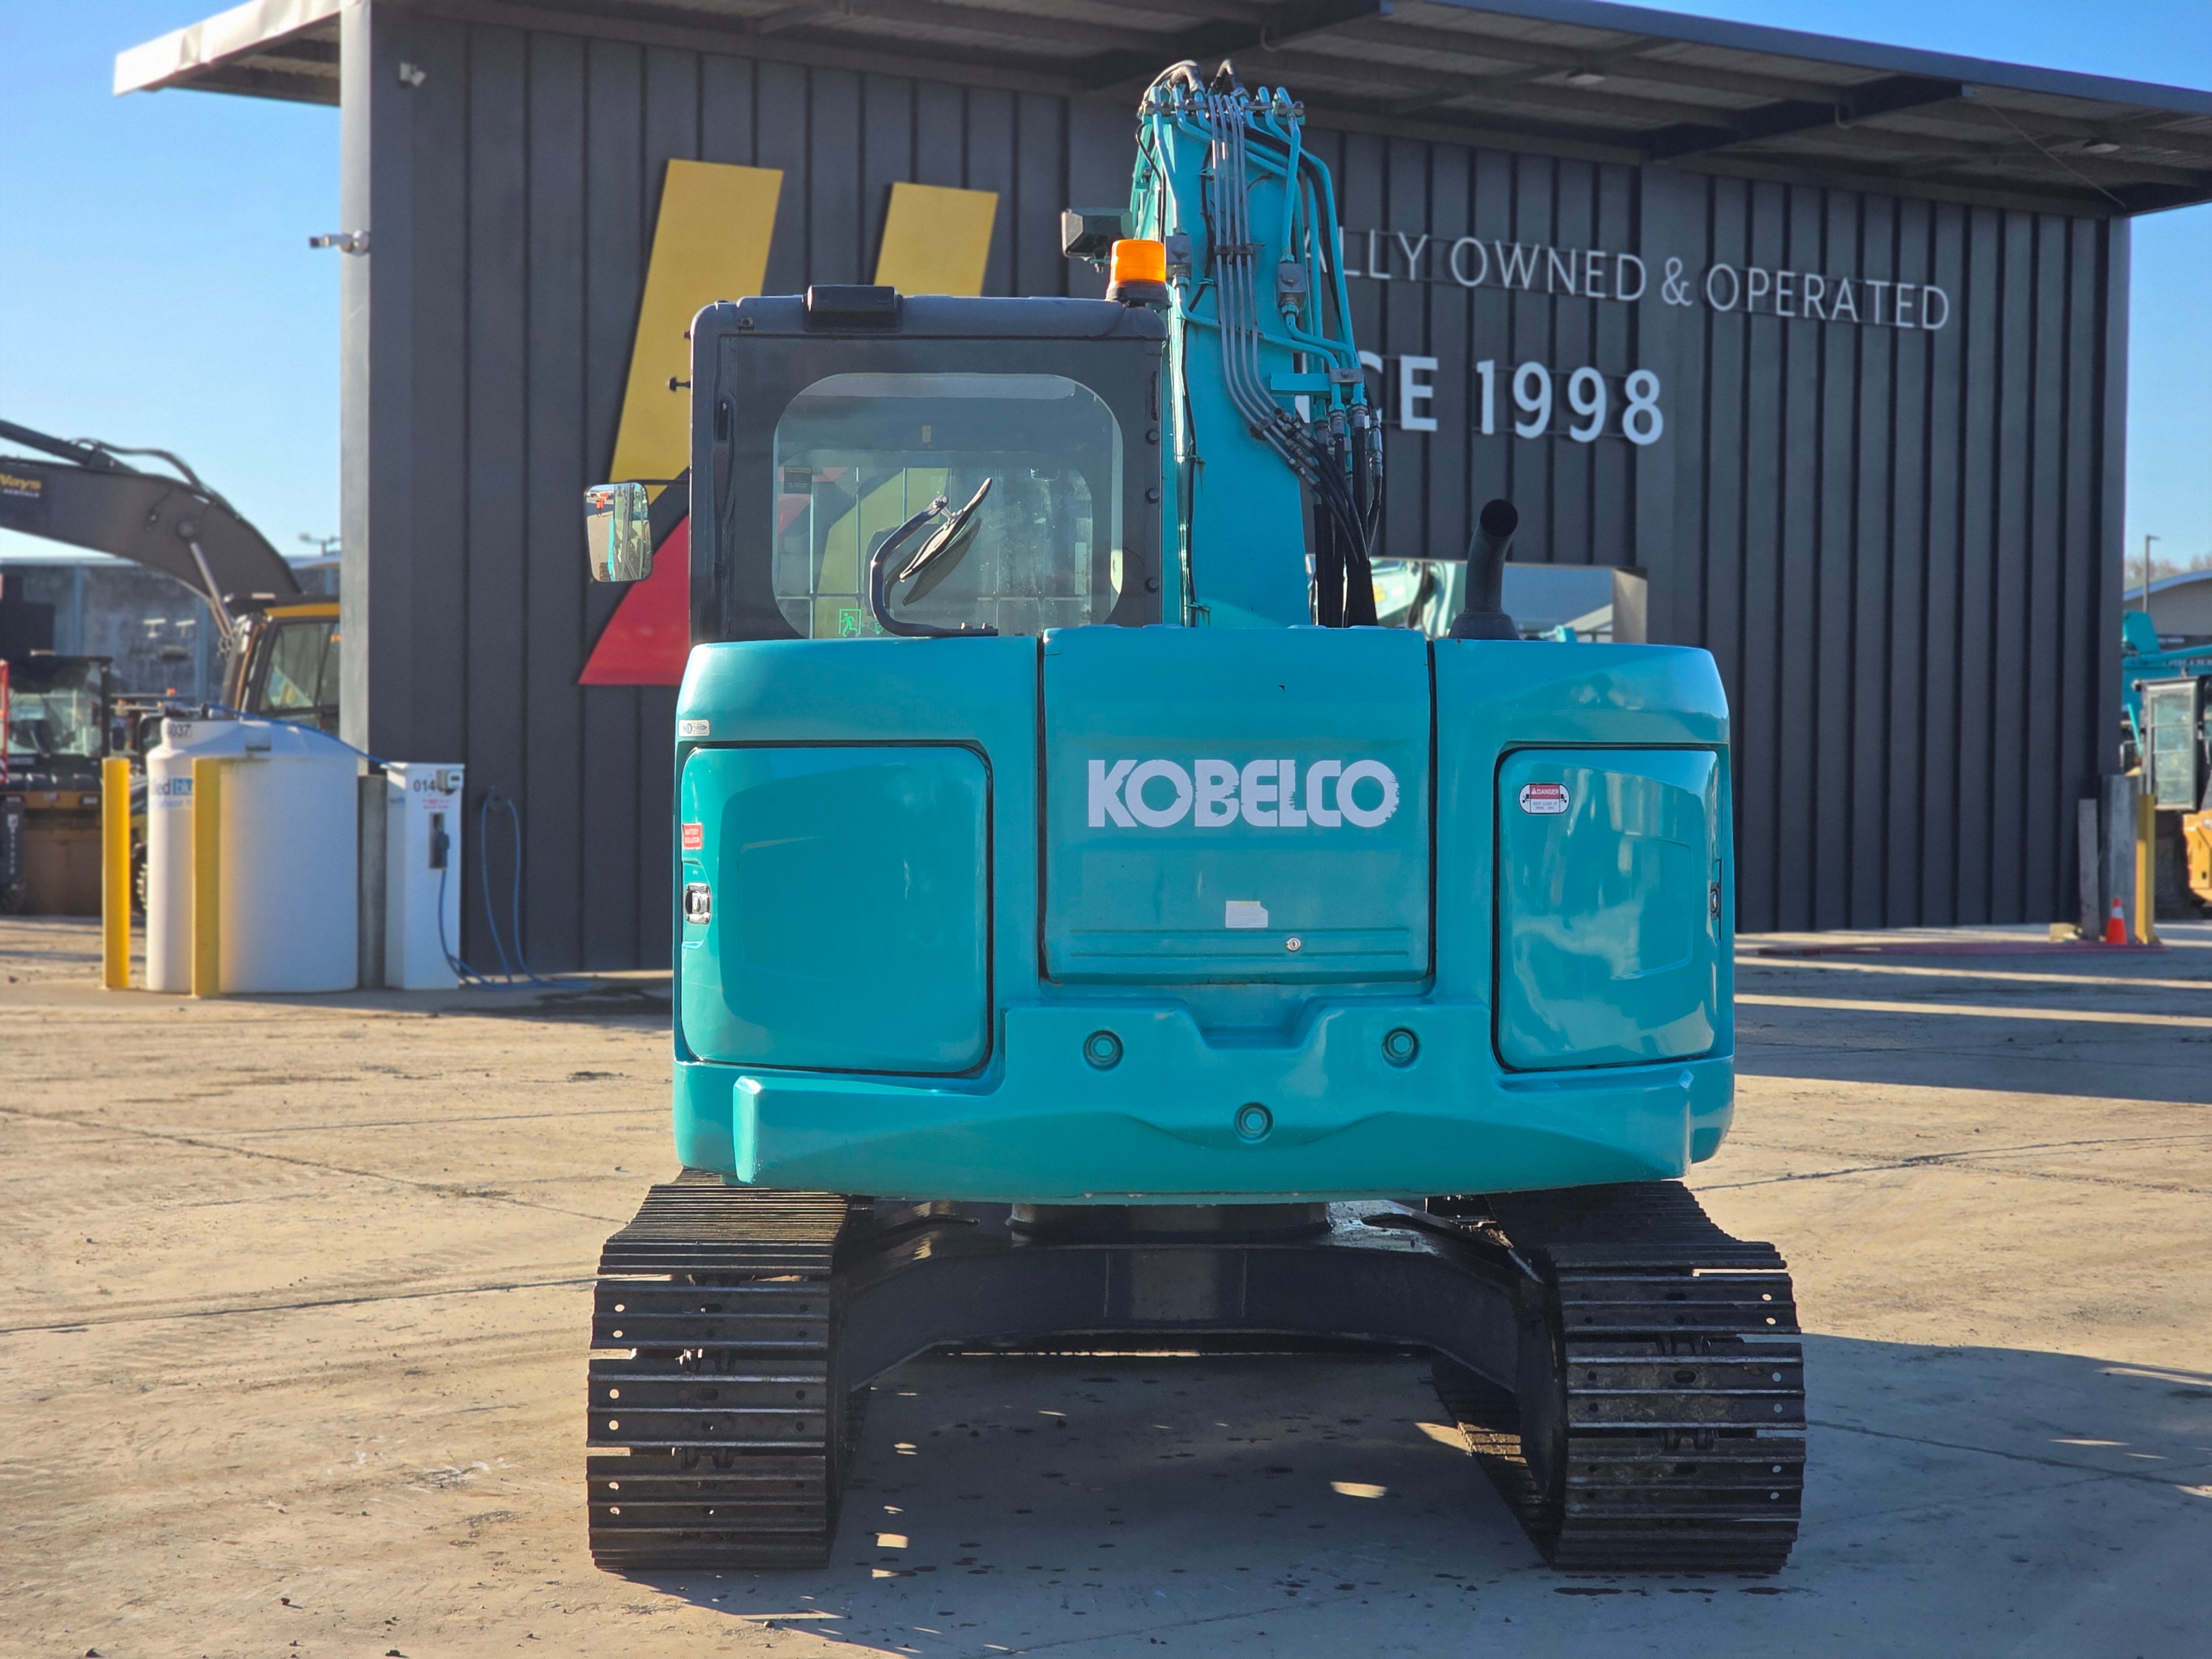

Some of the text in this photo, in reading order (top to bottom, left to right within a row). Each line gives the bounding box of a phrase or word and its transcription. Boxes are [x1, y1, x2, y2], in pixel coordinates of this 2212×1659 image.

[1451, 237, 1647, 301] OWNED
[1661, 257, 1693, 307] &
[1706, 263, 1949, 330] OPERATED
[1477, 359, 1663, 446] 1998
[1088, 759, 1400, 828] KOBELCO
